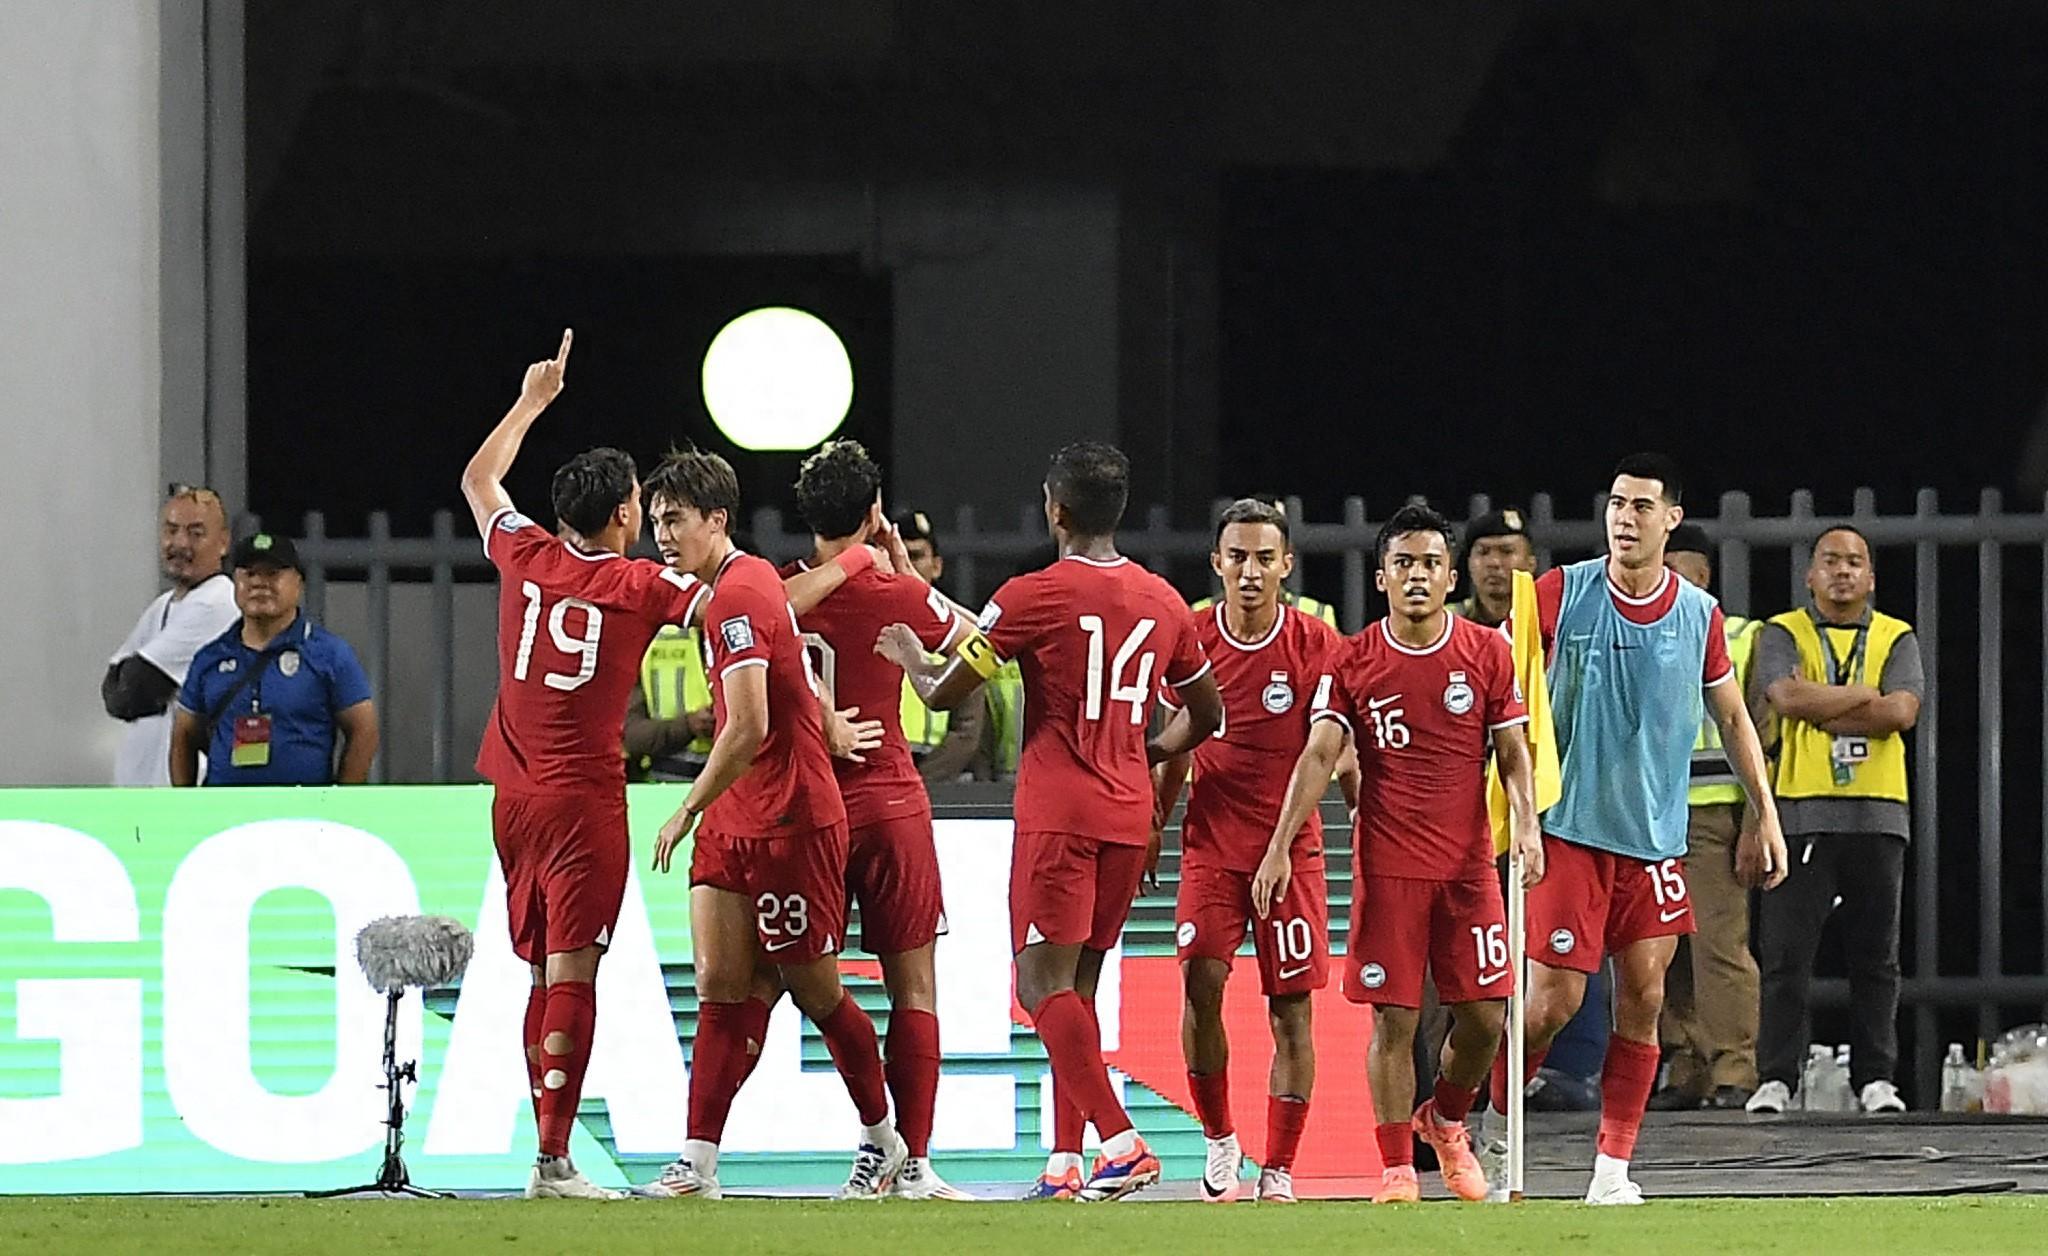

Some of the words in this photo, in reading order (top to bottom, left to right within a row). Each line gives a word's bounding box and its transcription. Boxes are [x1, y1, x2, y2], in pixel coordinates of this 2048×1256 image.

[514, 580, 603, 691] 19
[1079, 615, 1156, 724] 14
[1370, 708, 1410, 748] 16
[1645, 858, 1686, 906] 15
[757, 892, 808, 936] 23
[1272, 917, 1312, 962] 10
[1471, 924, 1507, 969] 16
